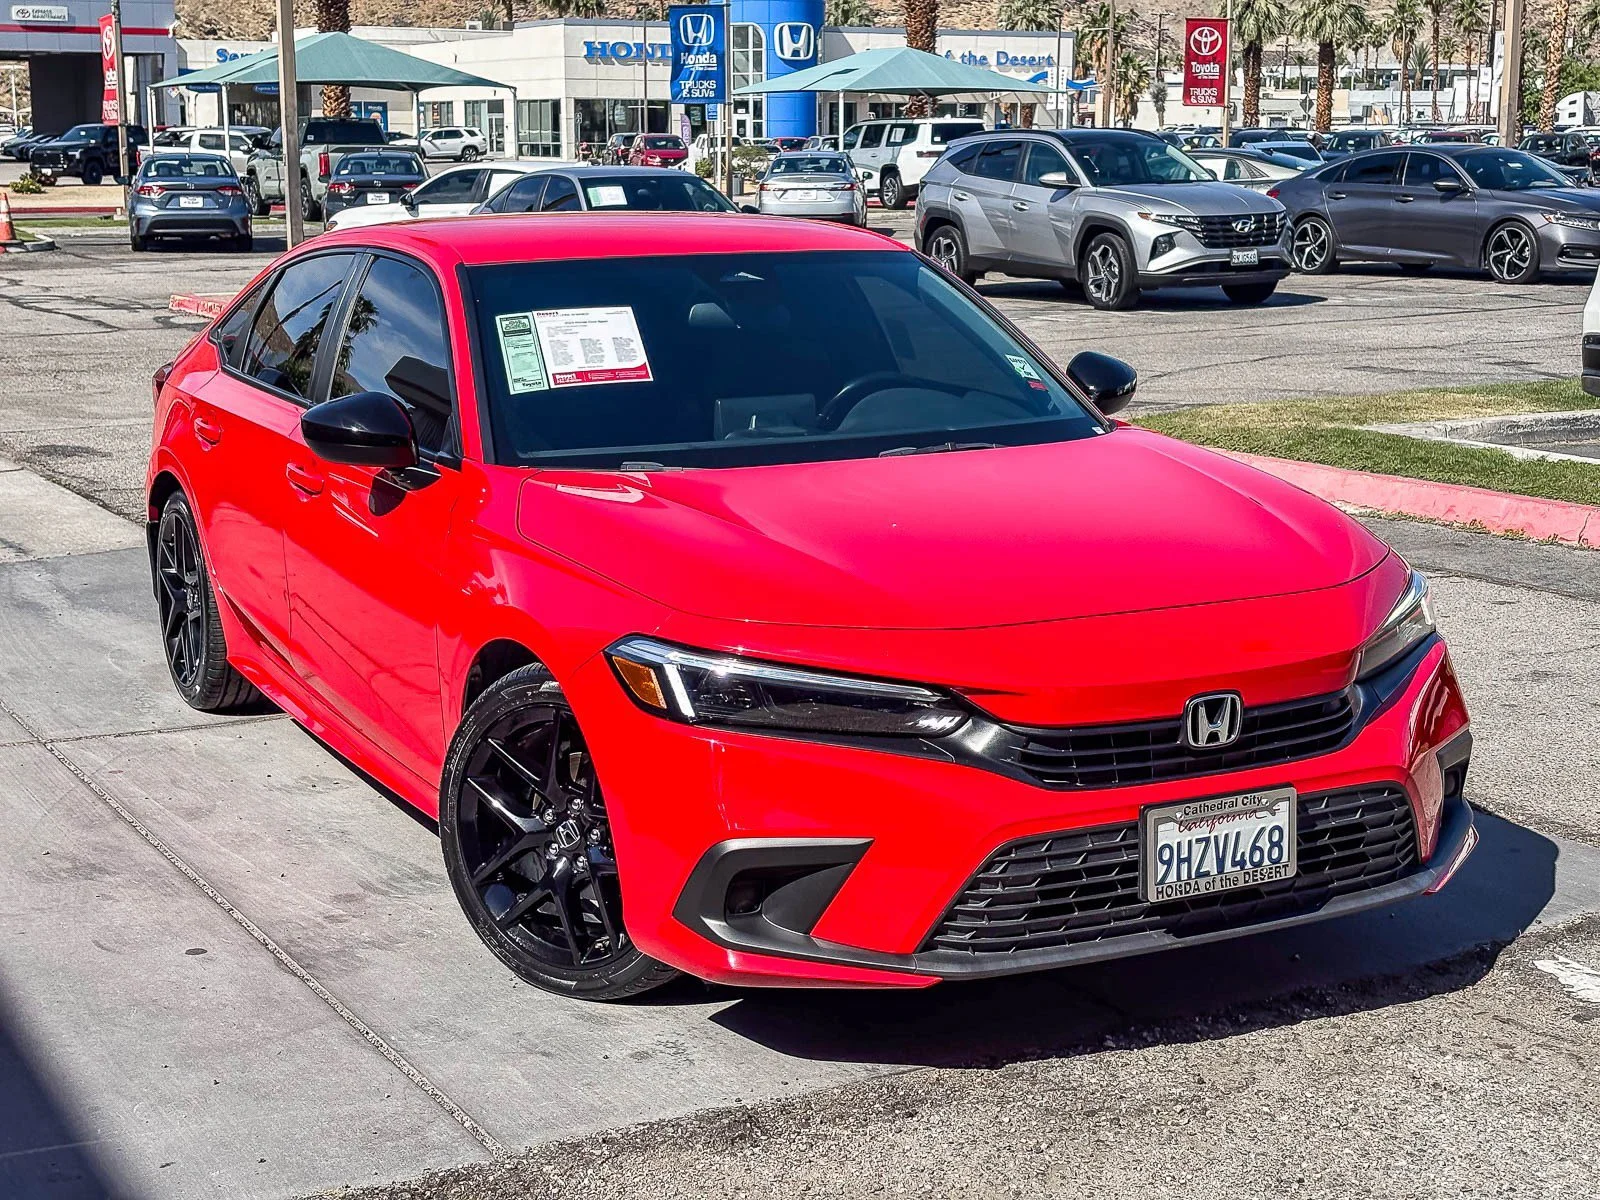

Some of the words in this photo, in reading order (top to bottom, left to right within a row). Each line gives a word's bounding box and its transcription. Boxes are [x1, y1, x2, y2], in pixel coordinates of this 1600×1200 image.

[680, 51, 717, 65] Honda
[960, 50, 988, 66] the
[996, 50, 1055, 67] Desert
[1190, 61, 1220, 75] Toyota
[679, 80, 717, 89] TRUCKS
[1189, 87, 1218, 96] TRUCKS
[691, 89, 715, 98] SUVs
[1197, 95, 1217, 104] SUVs
[1183, 797, 1239, 816] Cathedral
[1241, 794, 1263, 808] City
[1177, 808, 1267, 834] California
[1154, 824, 1284, 886] 9HZV468
[1155, 882, 1200, 900] HONDA
[1204, 878, 1216, 891] of
[1220, 874, 1240, 888] the
[1243, 863, 1290, 884] DESERT
